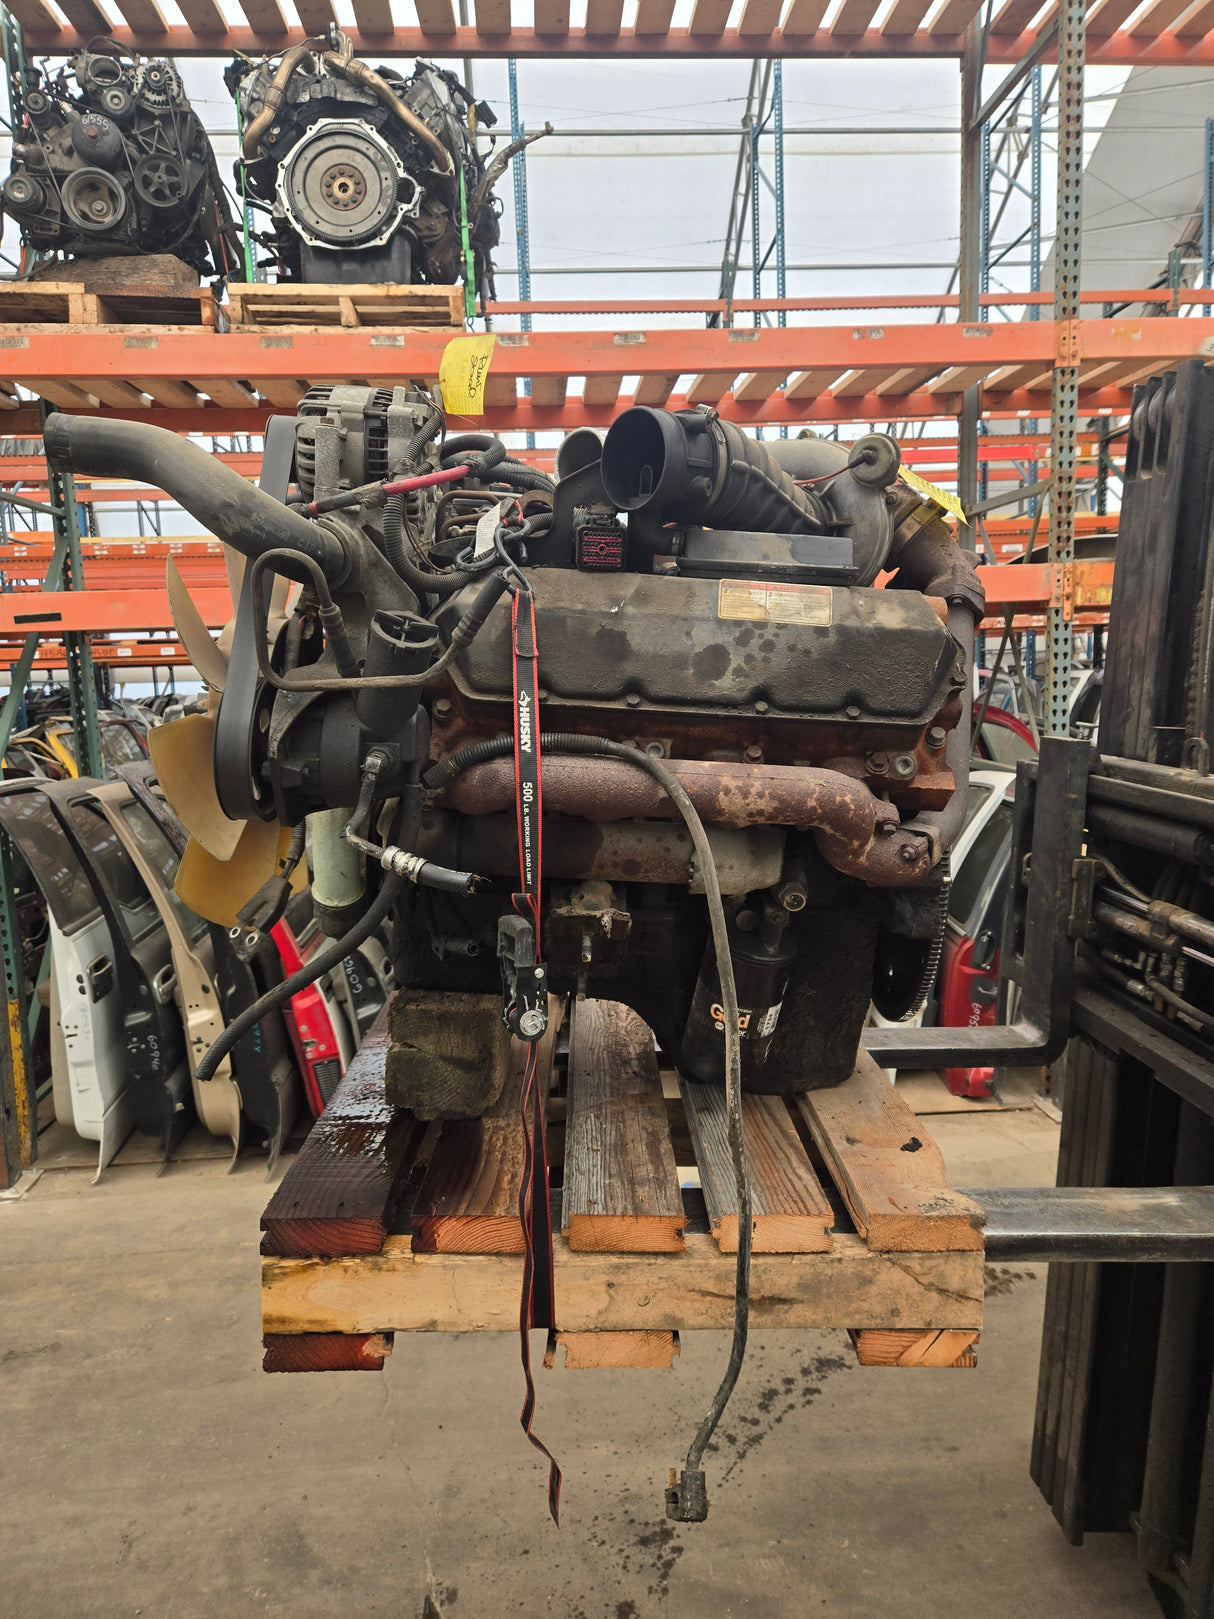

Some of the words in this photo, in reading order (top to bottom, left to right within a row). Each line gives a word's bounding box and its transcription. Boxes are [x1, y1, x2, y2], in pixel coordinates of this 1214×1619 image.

[519, 706, 532, 753] HUSKY
[523, 781, 533, 802] 500
[523, 815, 531, 847] WORKING
[710, 1003, 752, 1029] Gd
[968, 1002, 983, 1028] 6095
[147, 1034, 161, 1071] 60940
